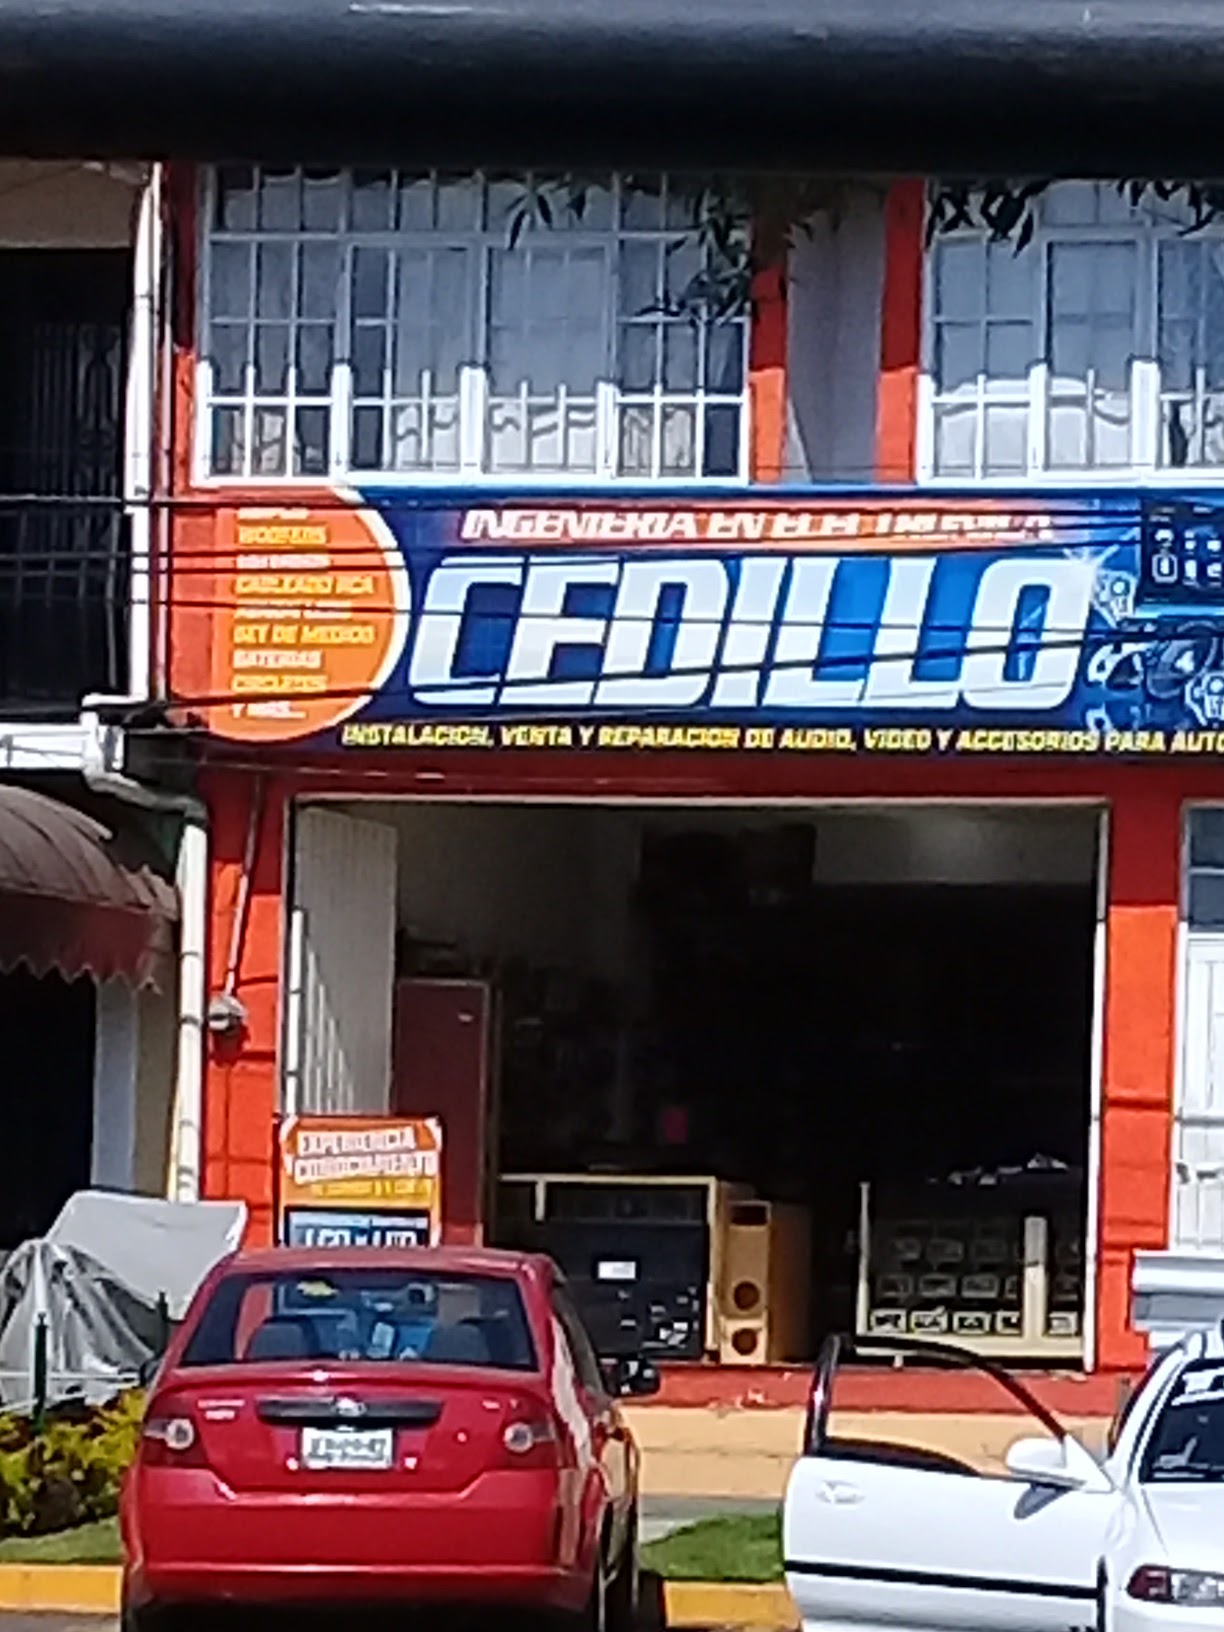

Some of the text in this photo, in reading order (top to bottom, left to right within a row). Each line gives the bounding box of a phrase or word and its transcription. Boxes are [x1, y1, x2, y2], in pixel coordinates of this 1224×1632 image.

[410, 556, 1096, 708] CEDILLO
[501, 725, 572, 747] VENTA
[578, 726, 595, 747] Y
[597, 725, 740, 748] REPARACION
[744, 728, 775, 749] DE
[863, 728, 932, 750] VIDEO
[936, 729, 953, 750] Y
[955, 730, 1098, 752] ACCESORIOS
[1104, 731, 1166, 752] PARA
